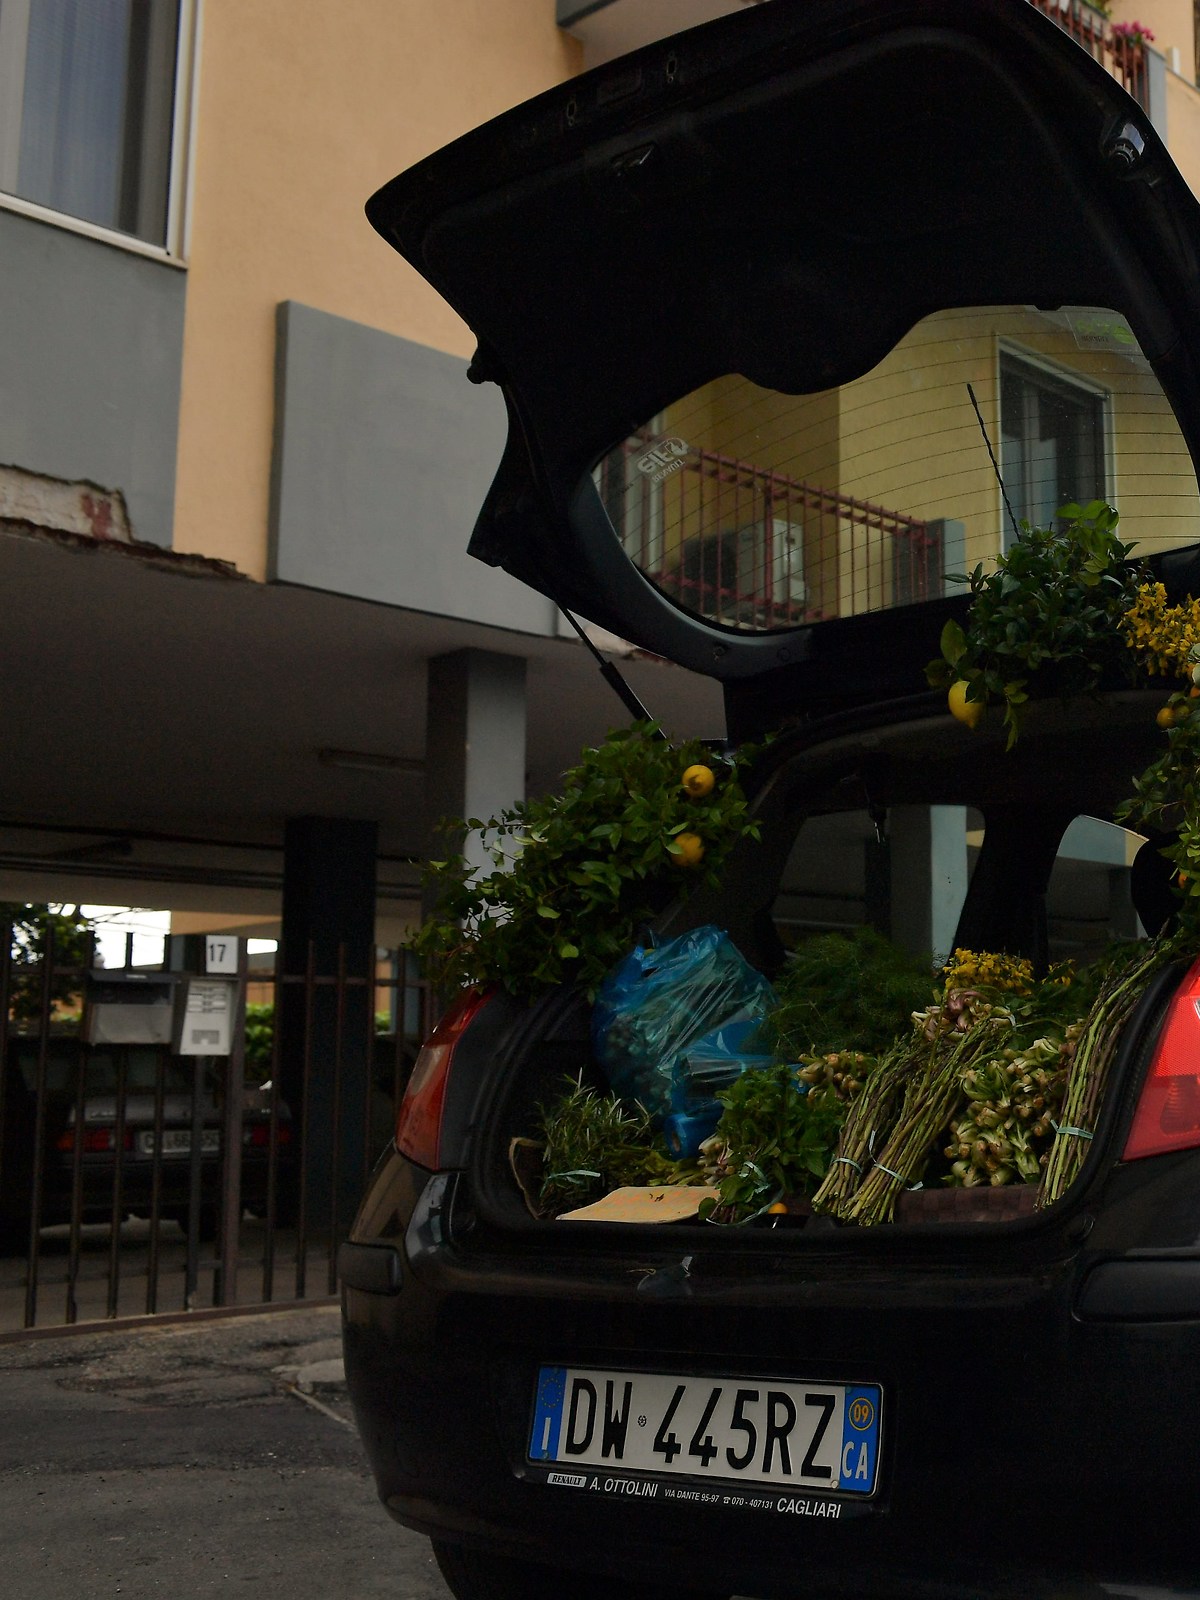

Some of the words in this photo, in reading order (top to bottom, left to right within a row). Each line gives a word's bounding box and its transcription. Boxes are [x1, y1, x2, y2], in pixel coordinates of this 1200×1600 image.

[210, 944, 226, 962] 17
[565, 1378, 633, 1460] DW
[652, 1385, 836, 1479] 445RZ
[854, 1404, 869, 1423] 09
[541, 1417, 552, 1451] I
[842, 1441, 868, 1480] CA
[552, 1474, 582, 1486] RENAULT
[589, 1477, 601, 1491] A.
[604, 1478, 659, 1497] OTTOLINI
[664, 1489, 675, 1498] VIA
[676, 1490, 700, 1501] DANTE
[701, 1493, 720, 1503] 95-97
[731, 1497, 744, 1506] 070
[749, 1498, 773, 1509] 407131
[777, 1498, 842, 1519] CAGLIARI
